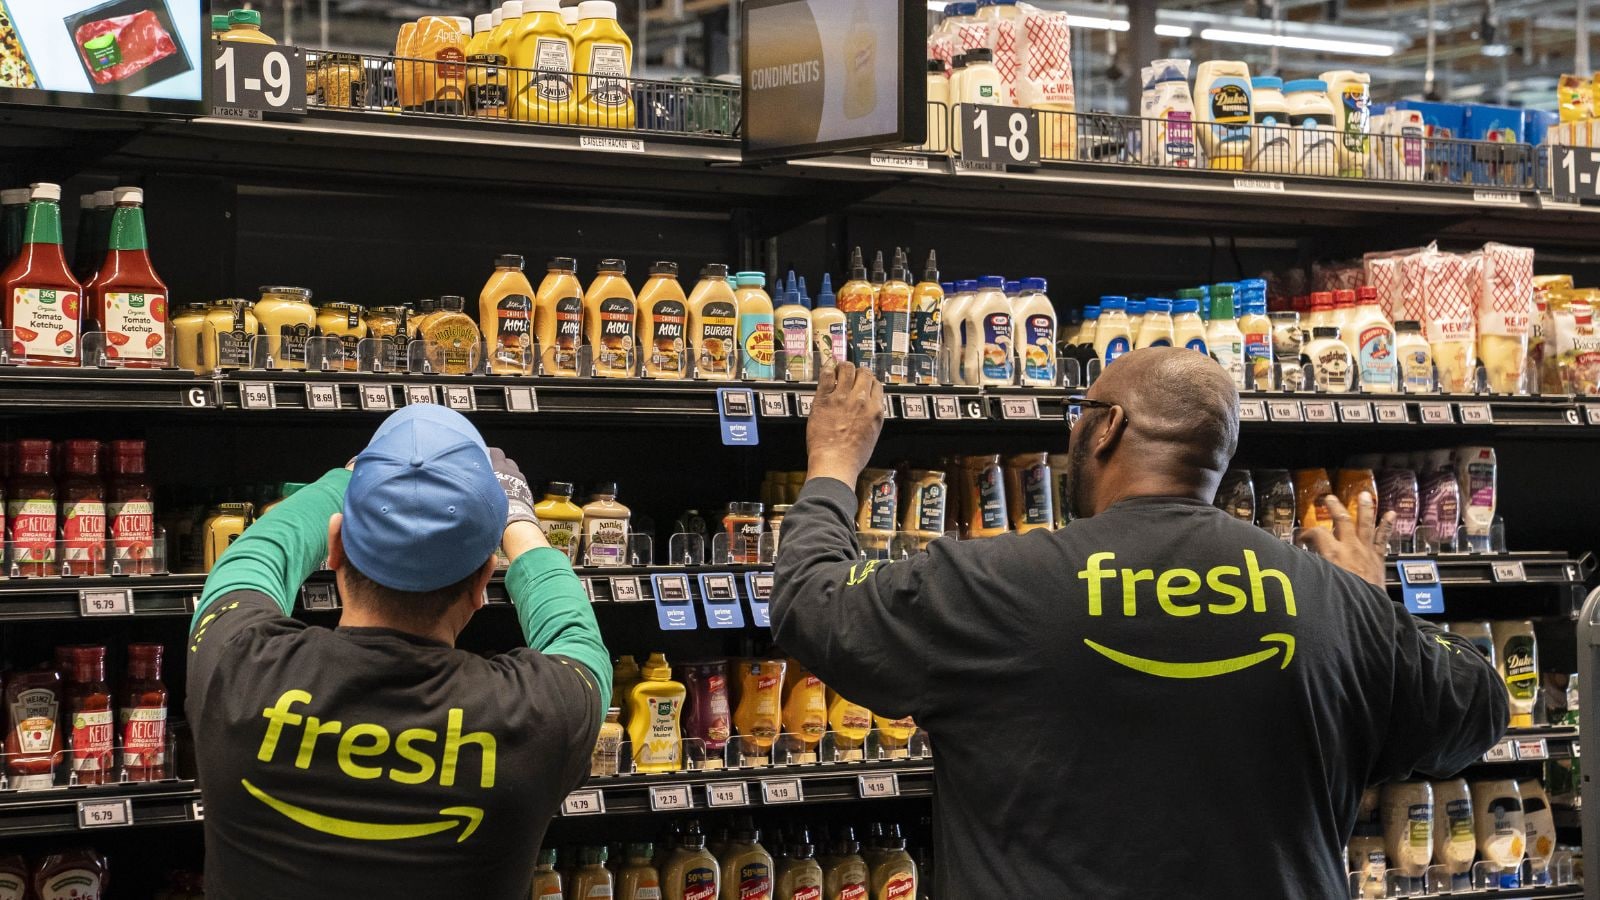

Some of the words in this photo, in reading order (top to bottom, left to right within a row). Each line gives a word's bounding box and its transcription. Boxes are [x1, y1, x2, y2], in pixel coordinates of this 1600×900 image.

[214, 47, 291, 107] 1-9
[751, 60, 820, 91] CONDIMENTS
[973, 110, 1030, 161] 1-8
[40, 290, 55, 299] 365
[130, 294, 144, 303] 365
[32, 311, 63, 321] Tomato
[123, 315, 151, 325] Tomato
[30, 320, 64, 331] Ketchup
[121, 324, 153, 334] Ketchup
[704, 325, 733, 336] BURGER
[188, 387, 206, 408] G
[246, 392, 267, 402] $5.99
[313, 393, 333, 403] $8.69
[367, 393, 386, 404] $5.99
[411, 394, 430, 404] $5.99
[450, 394, 468, 404] $5.29
[765, 401, 782, 410] $4.99
[906, 404, 922, 413] $5.79
[939, 404, 954, 413] $5.79
[967, 402, 981, 418] G
[1565, 409, 1579, 424] G
[729, 424, 747, 432] prime
[599, 519, 623, 531] Annie's
[1078, 549, 1297, 617] fresh
[617, 585, 634, 595] $5.39
[1416, 591, 1431, 600] prime
[93, 600, 114, 610] $6.79
[667, 609, 685, 617] prime
[714, 608, 731, 617] prime
[25, 695, 48, 704] HEINZ
[660, 704, 670, 712] 365
[652, 724, 673, 733] Yellow
[257, 689, 497, 788] fresh
[867, 783, 885, 792] $4.19
[716, 791, 734, 801] $4.19
[771, 788, 788, 798] $4.19
[659, 795, 678, 804] $2.79
[570, 801, 589, 810] $4.79
[91, 810, 113, 821] $6.79
[684, 884, 716, 900] French's
[740, 881, 769, 900] French's
[795, 889, 820, 900] French's
[841, 886, 866, 900] French's
[888, 882, 913, 897] French's
